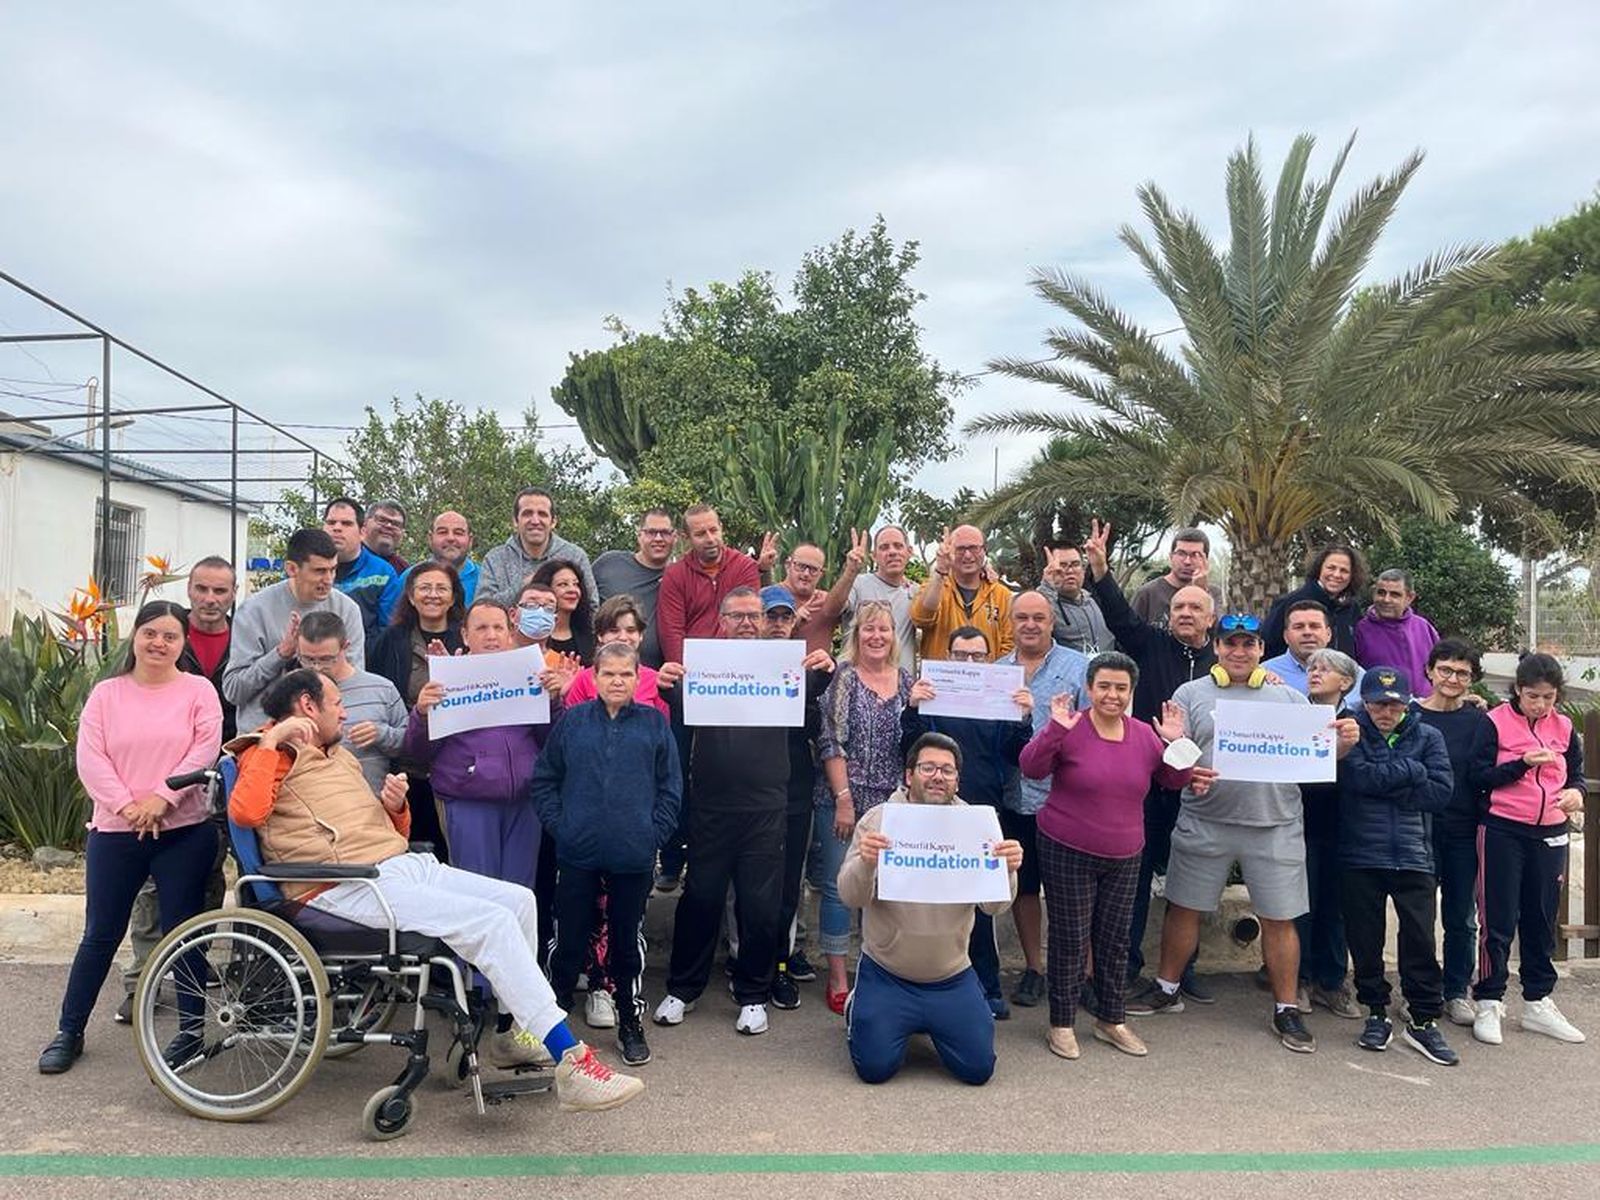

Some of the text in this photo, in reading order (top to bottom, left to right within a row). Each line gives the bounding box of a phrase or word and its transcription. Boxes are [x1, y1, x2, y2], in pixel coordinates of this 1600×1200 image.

[688, 681, 780, 696] Foundation
[1219, 739, 1310, 756] Foundation
[884, 850, 980, 869] Foundation
